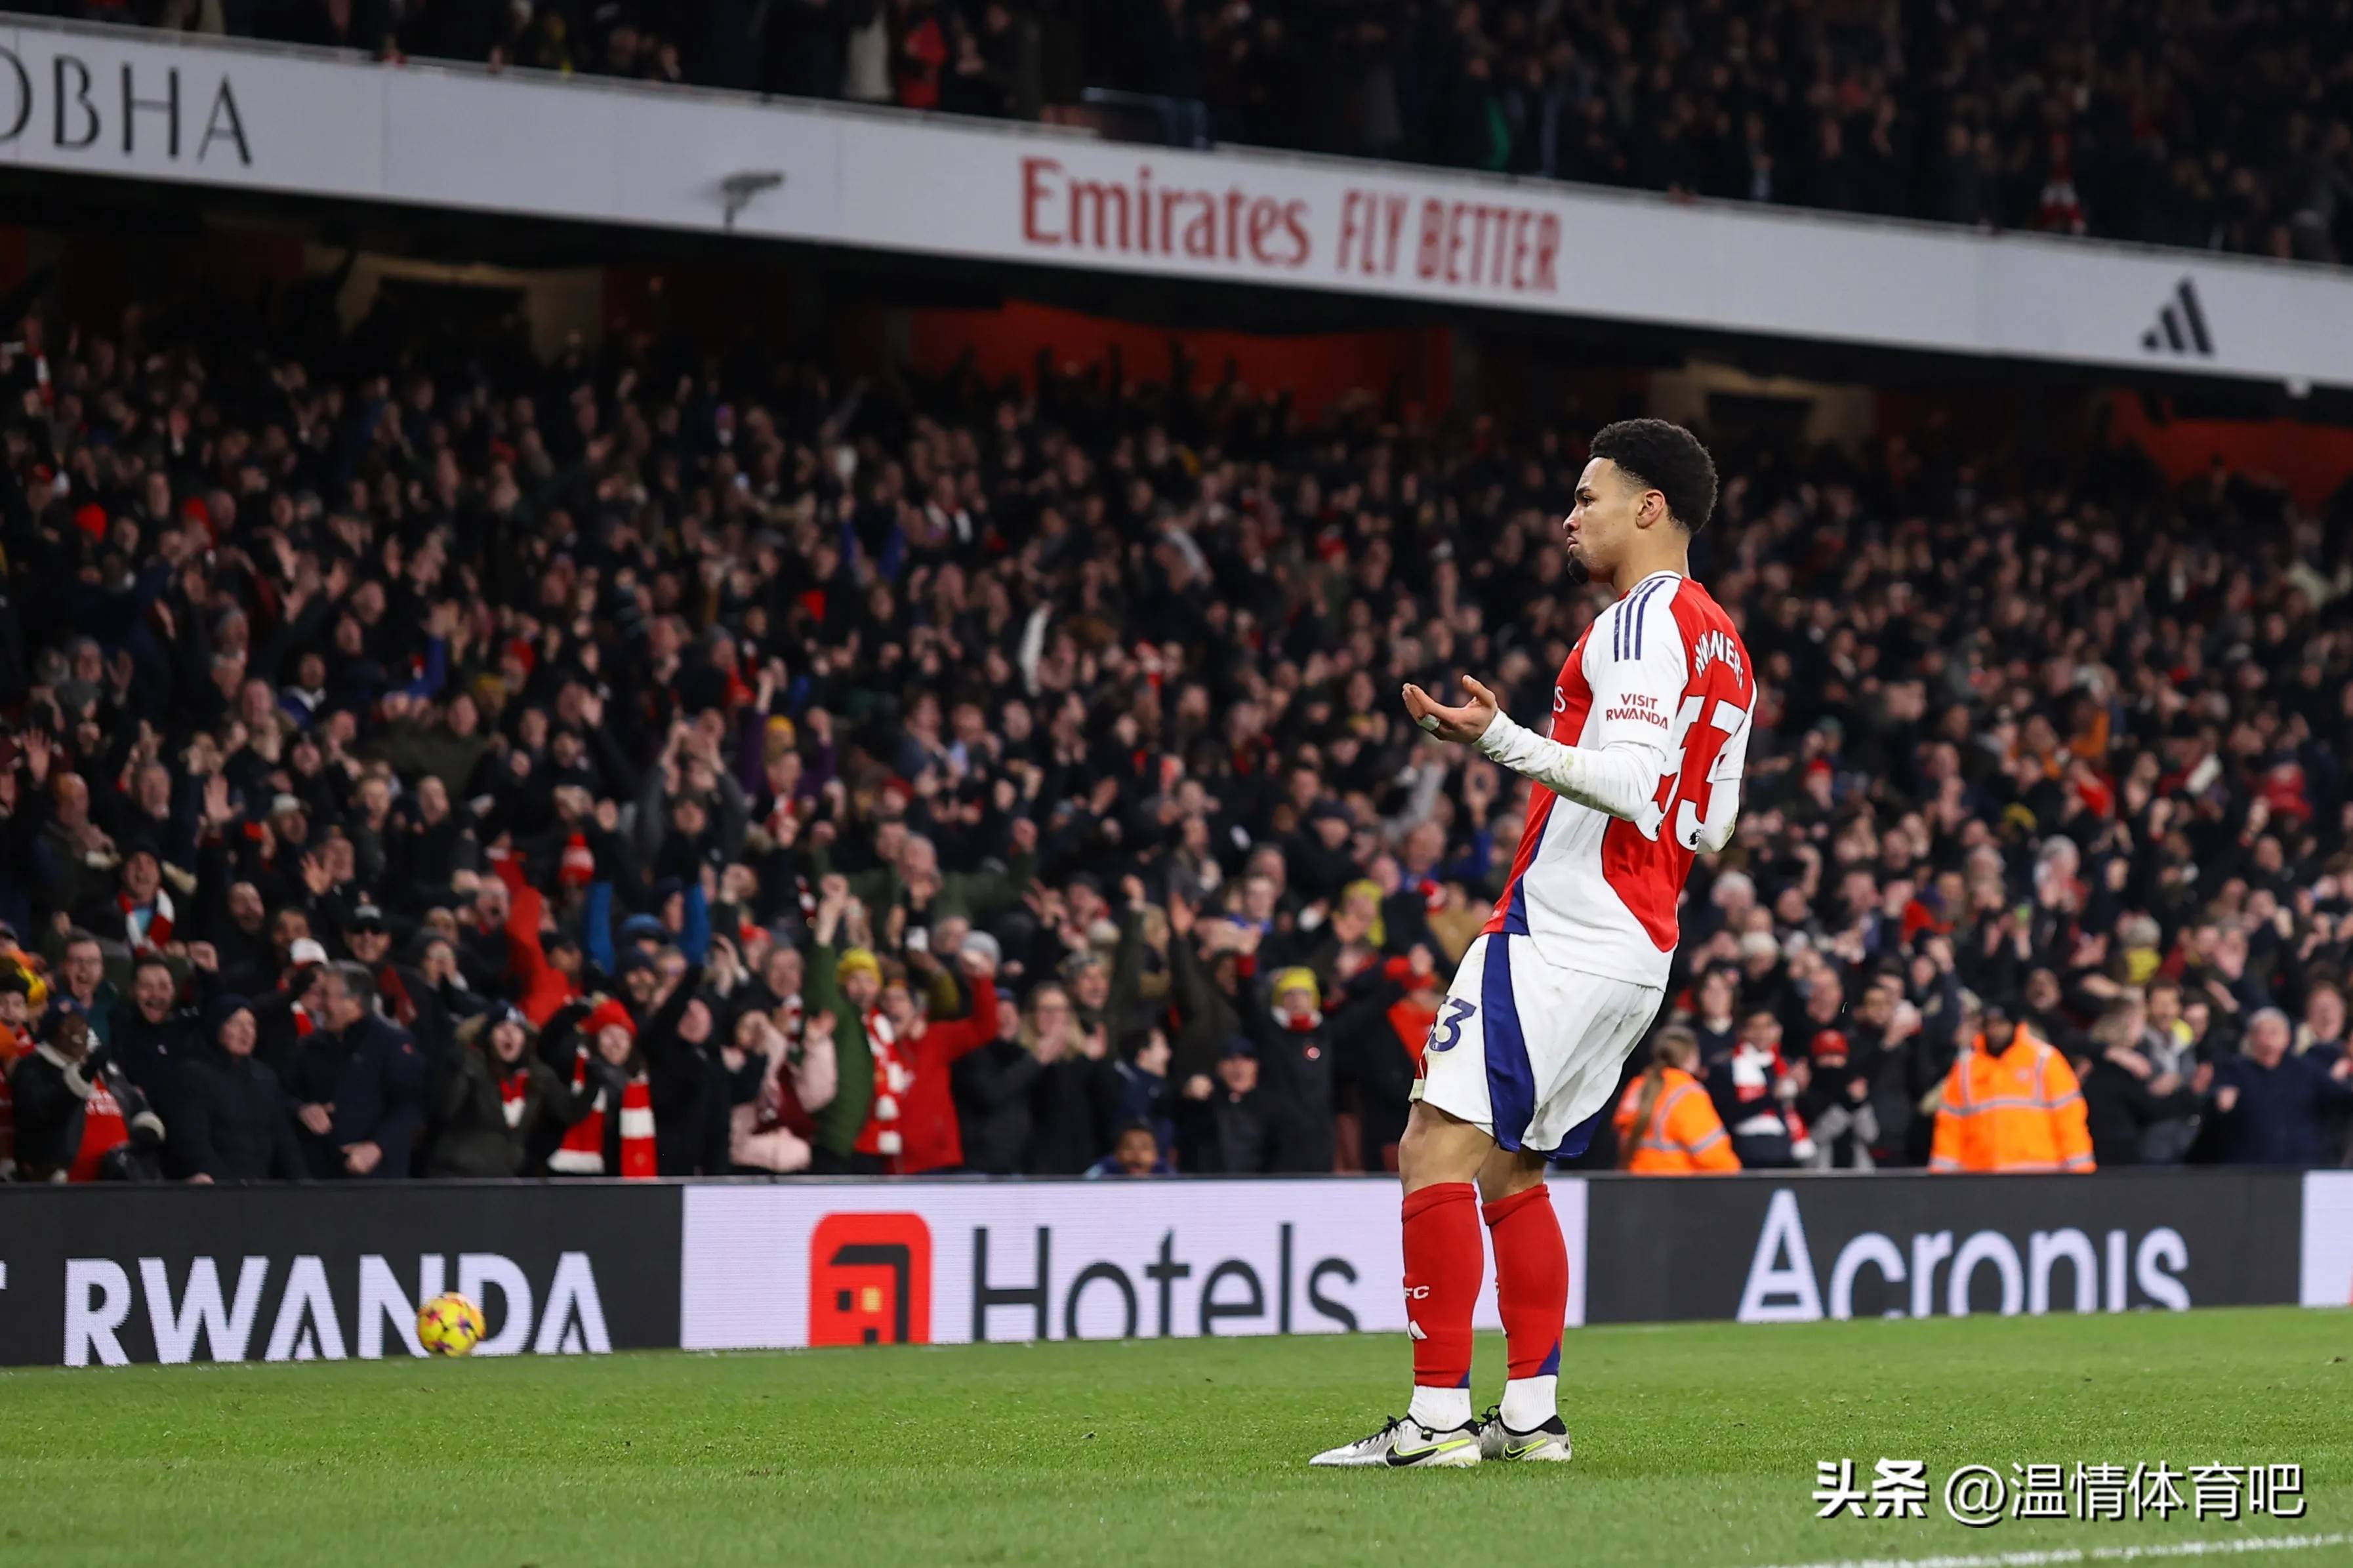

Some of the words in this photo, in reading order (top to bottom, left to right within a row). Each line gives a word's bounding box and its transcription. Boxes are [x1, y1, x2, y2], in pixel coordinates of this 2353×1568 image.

[1021, 155, 1311, 266] Emirates
[1338, 188, 1408, 276] FLY
[1417, 197, 1560, 292] BETTER
[1606, 708, 1668, 730] RWANDA
[1620, 693, 1658, 709] VISIT
[1429, 995, 1477, 1053] 3
[64, 1251, 612, 1367] RWANDA
[972, 1222, 1361, 1340] Hotels
[1737, 1190, 2190, 1323] Acronis
